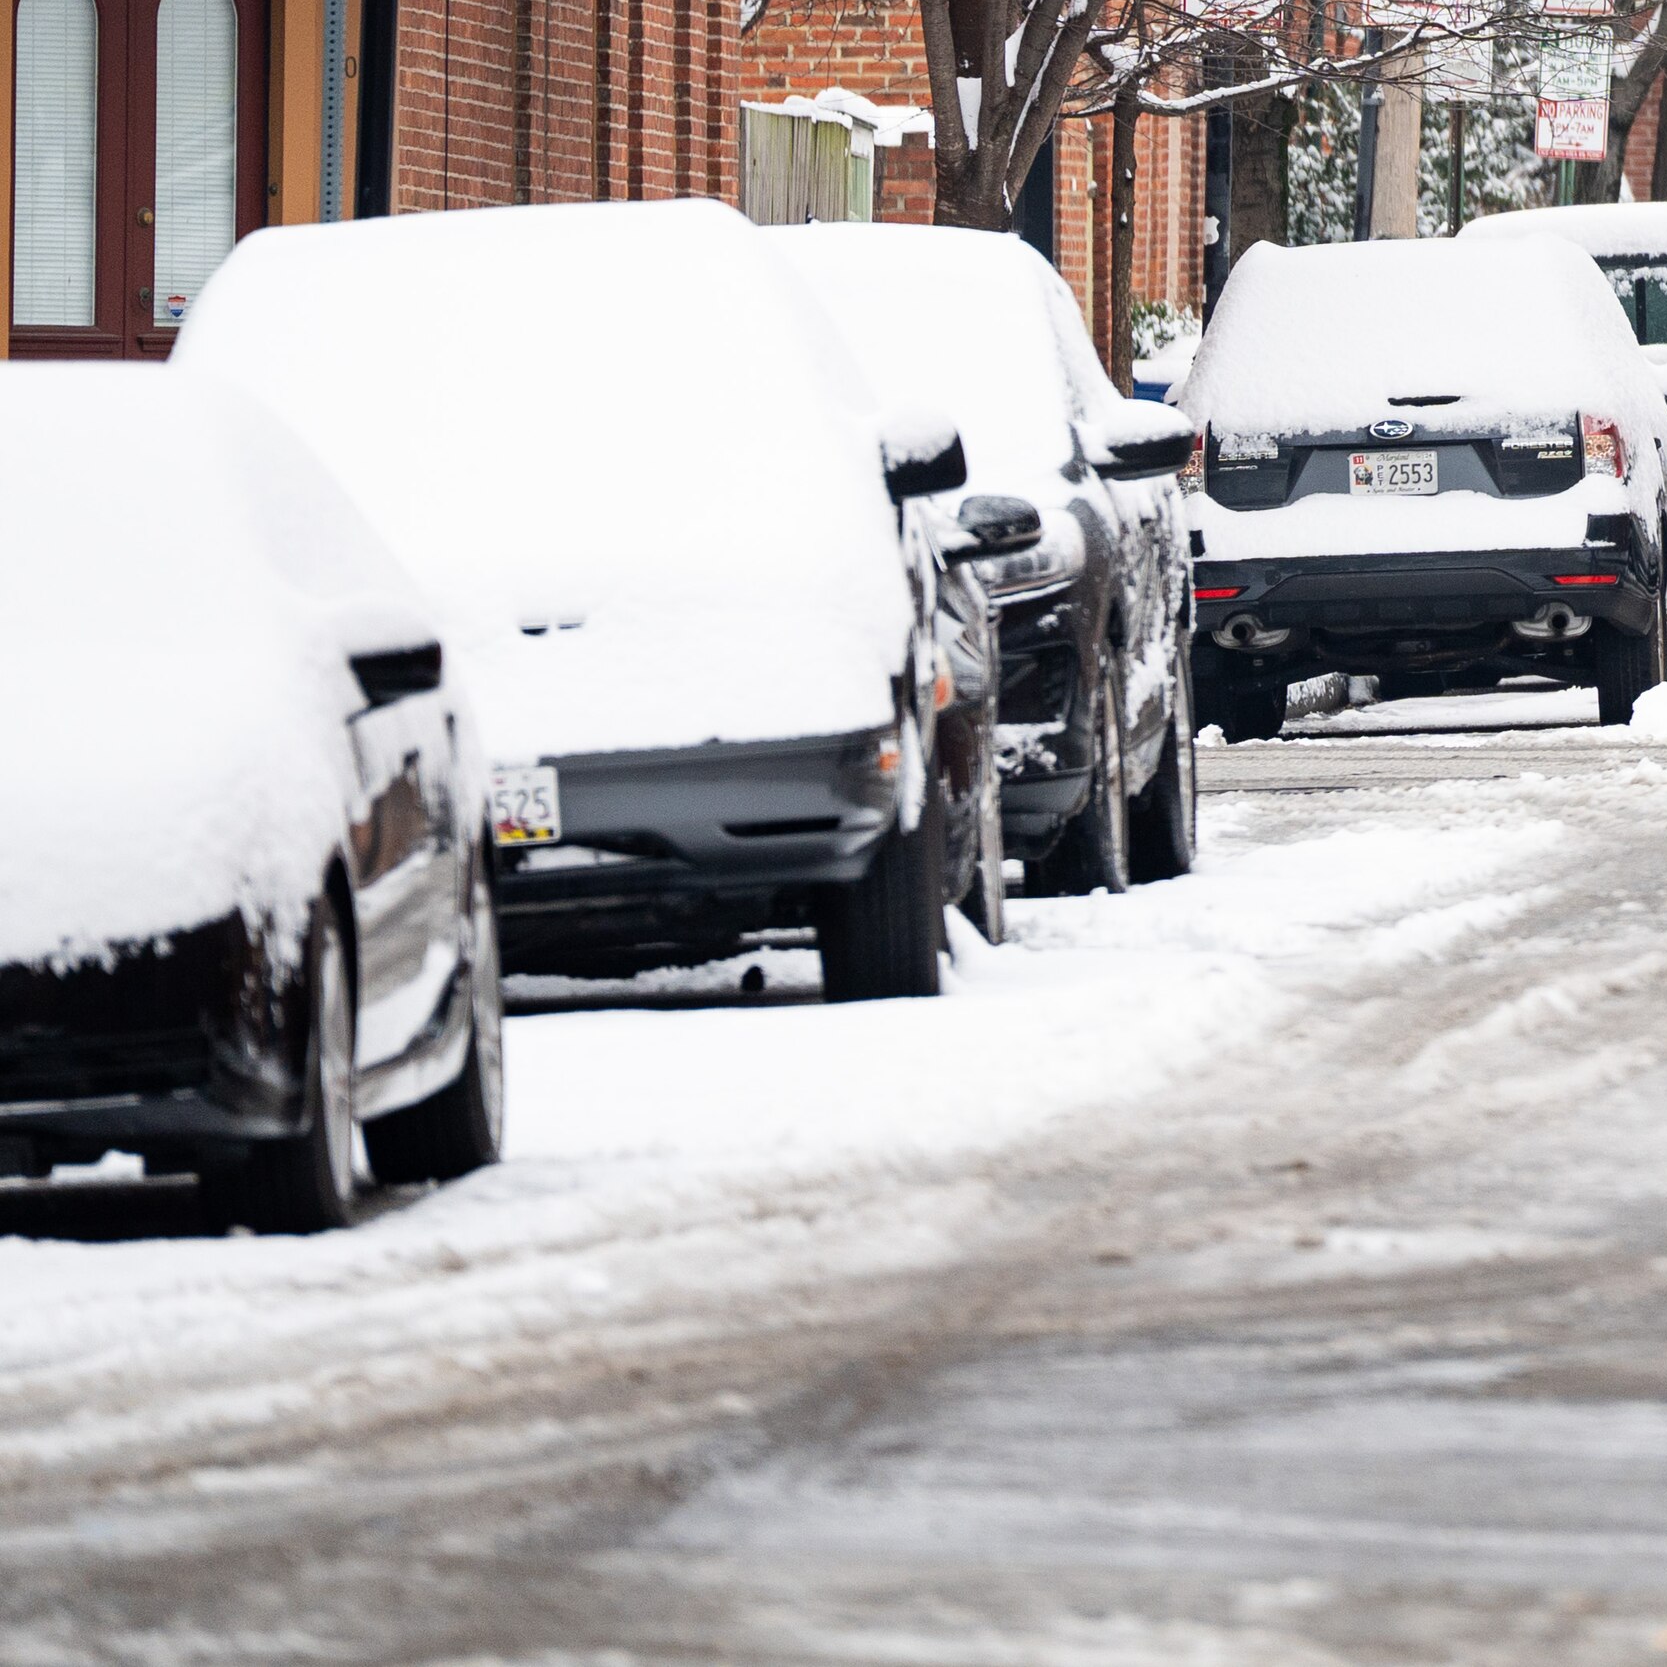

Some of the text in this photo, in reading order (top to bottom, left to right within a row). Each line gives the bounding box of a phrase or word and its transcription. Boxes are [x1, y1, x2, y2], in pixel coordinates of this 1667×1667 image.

[1541, 103, 1603, 121] NO PARKING
[1389, 463, 1433, 486] 2553
